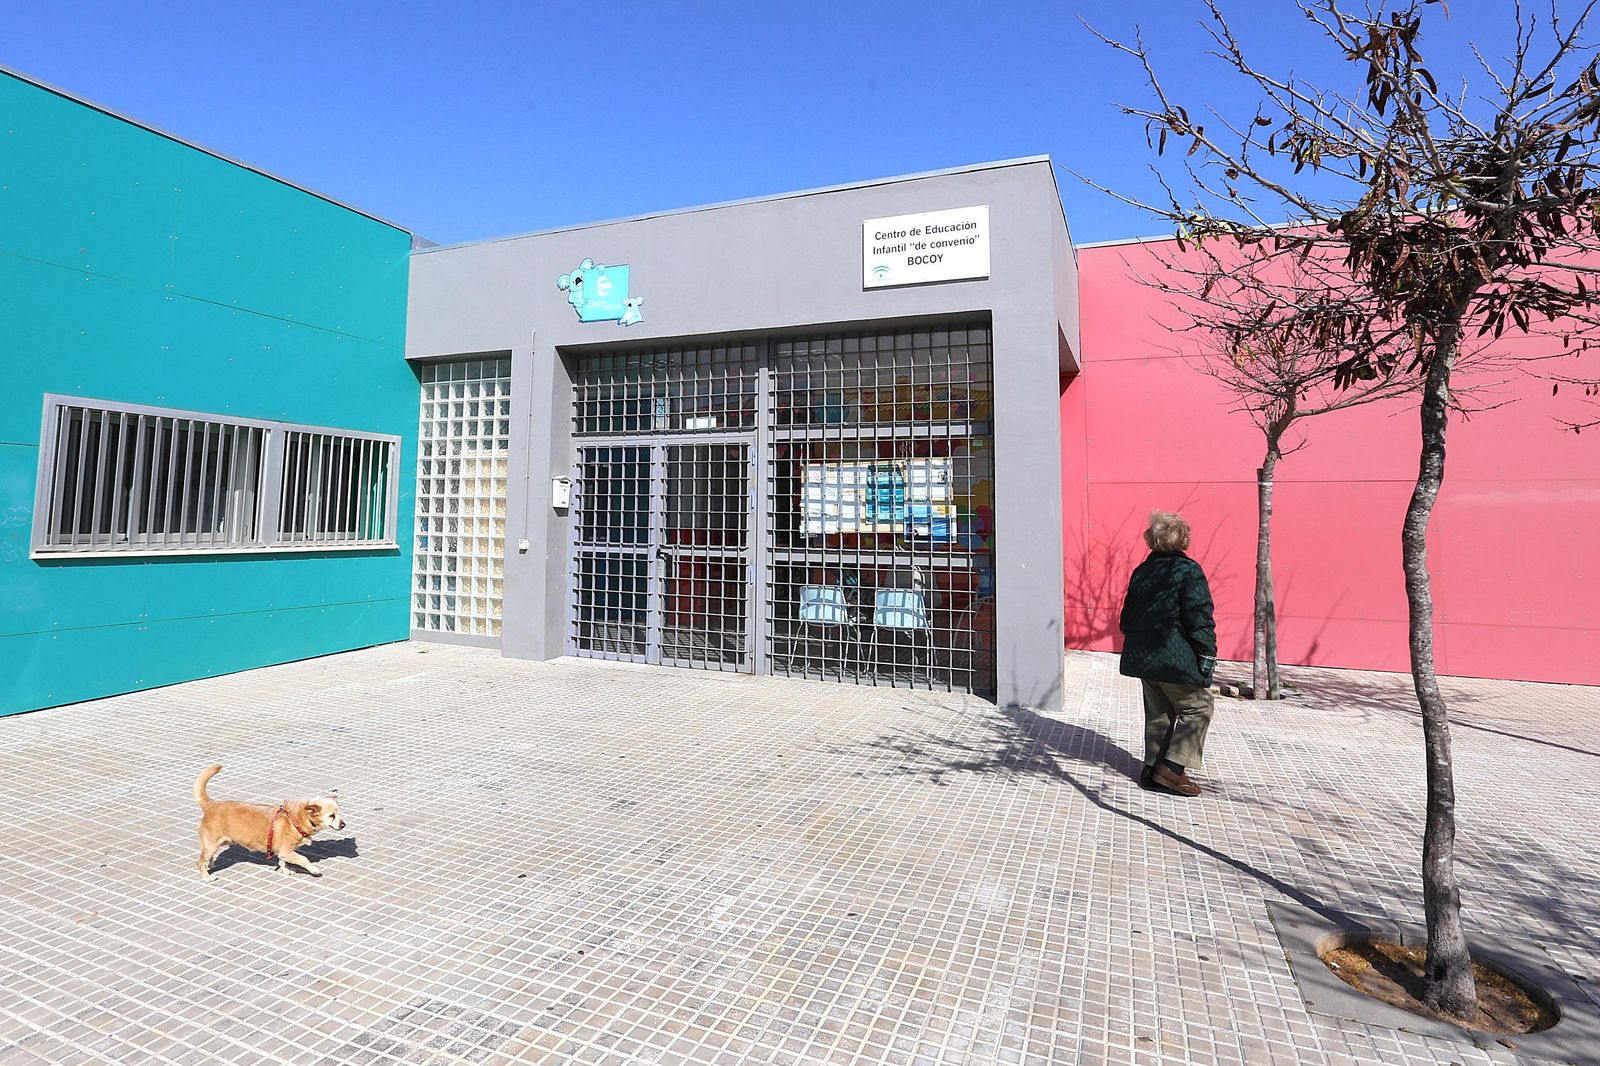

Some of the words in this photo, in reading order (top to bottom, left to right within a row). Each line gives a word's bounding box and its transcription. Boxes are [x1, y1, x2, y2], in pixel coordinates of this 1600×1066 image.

[874, 229, 906, 241] Centro
[909, 227, 922, 237] de
[925, 220, 977, 235] Educación
[872, 243, 907, 255] Infantil
[907, 253, 944, 266] BOCOY
